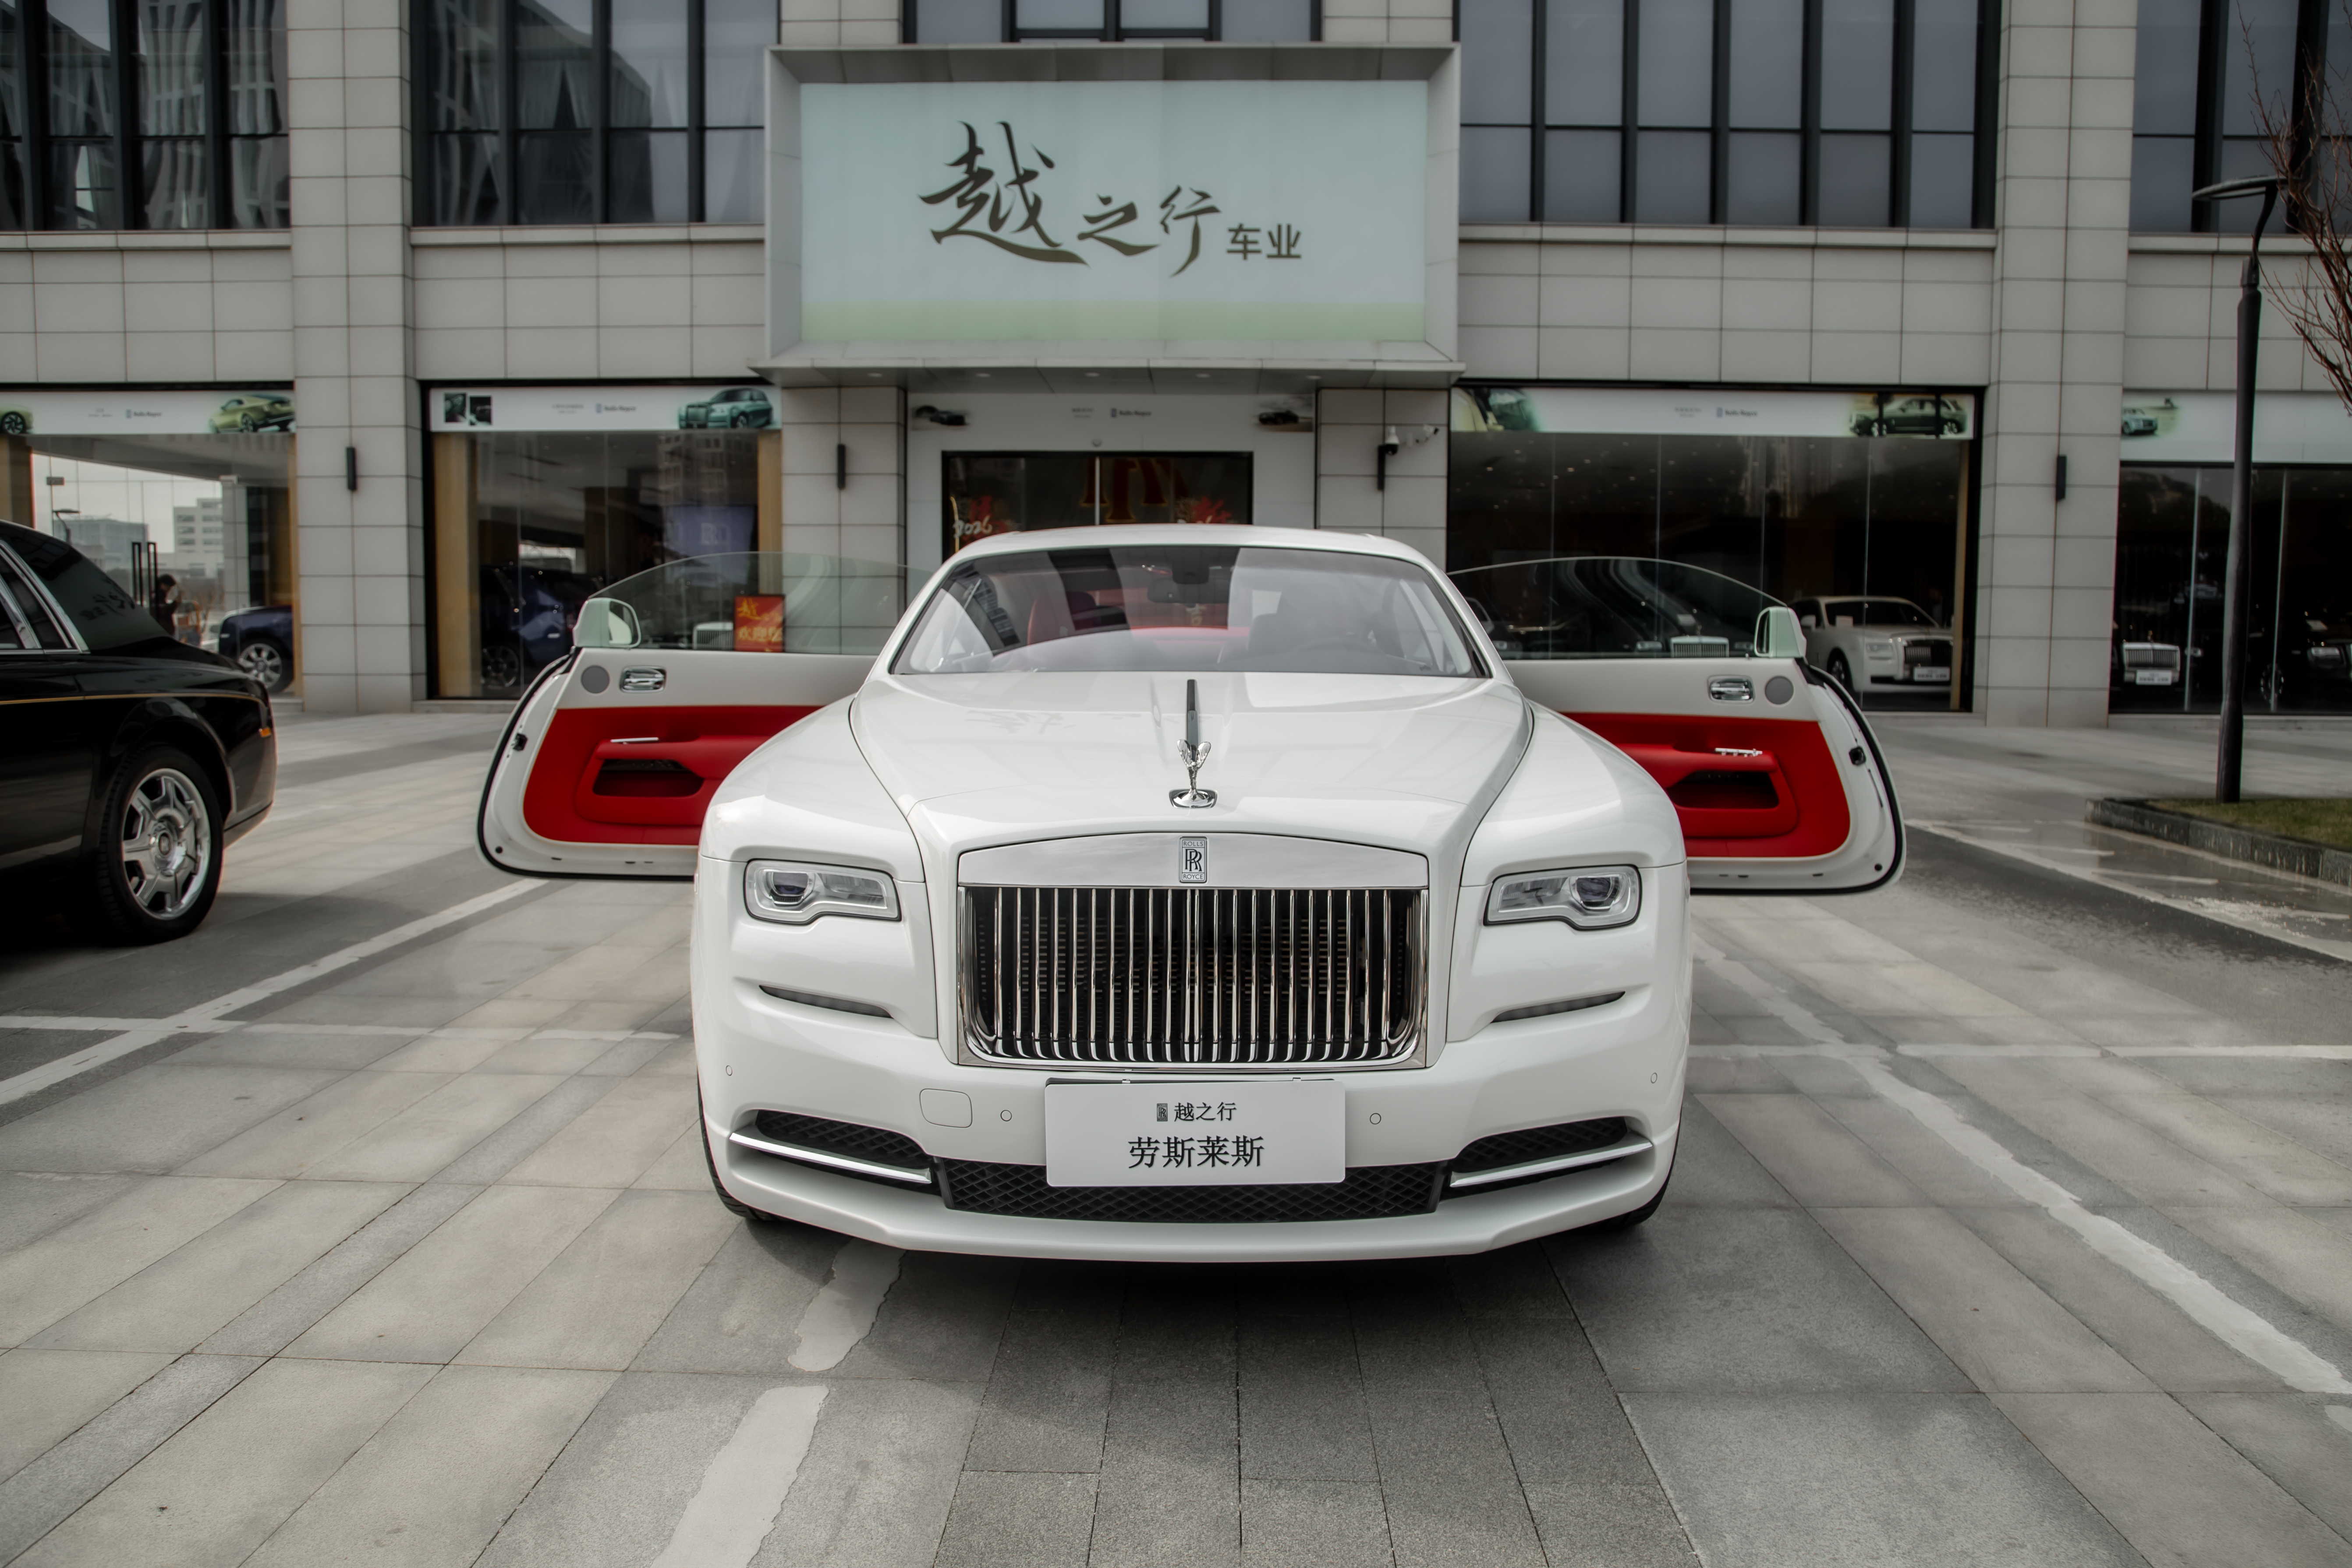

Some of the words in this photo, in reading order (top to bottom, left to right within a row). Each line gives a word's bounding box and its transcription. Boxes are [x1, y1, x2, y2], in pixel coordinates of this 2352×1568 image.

[1185, 848, 1202, 872] RR
[1174, 1102, 1237, 1122] 越之行
[1128, 1135, 1265, 1168] 劳斯莱斯
